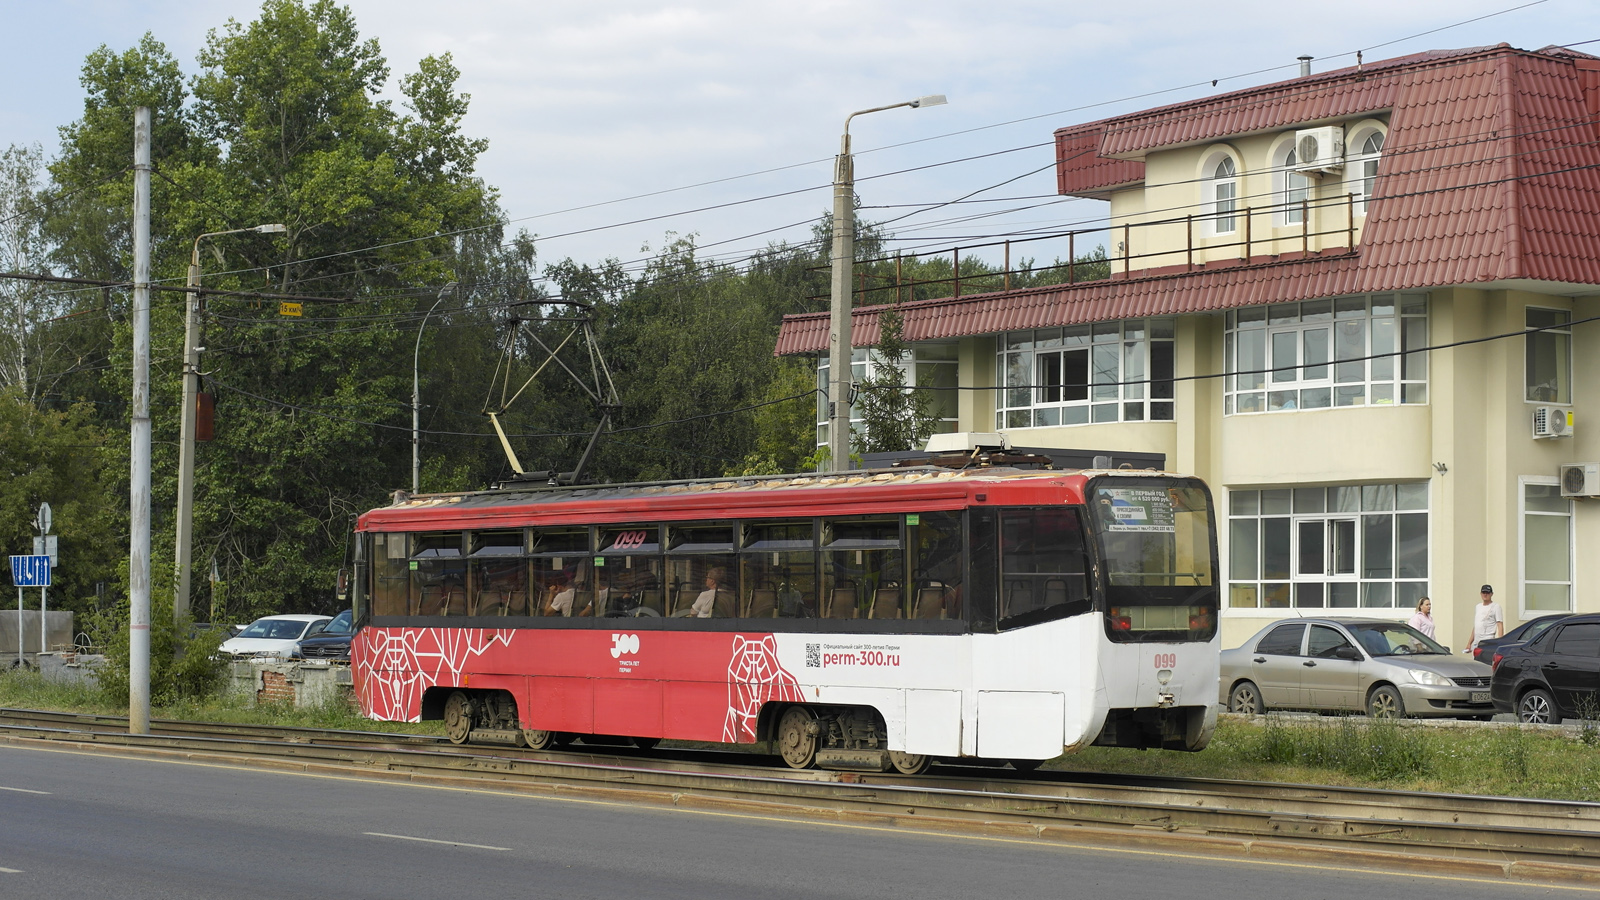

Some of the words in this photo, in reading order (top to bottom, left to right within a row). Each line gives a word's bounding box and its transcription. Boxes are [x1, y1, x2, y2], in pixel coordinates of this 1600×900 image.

[613, 530, 647, 549] 099
[610, 633, 640, 659] 300
[823, 651, 900, 668] perm-300.ru
[1154, 653, 1176, 669] 099
